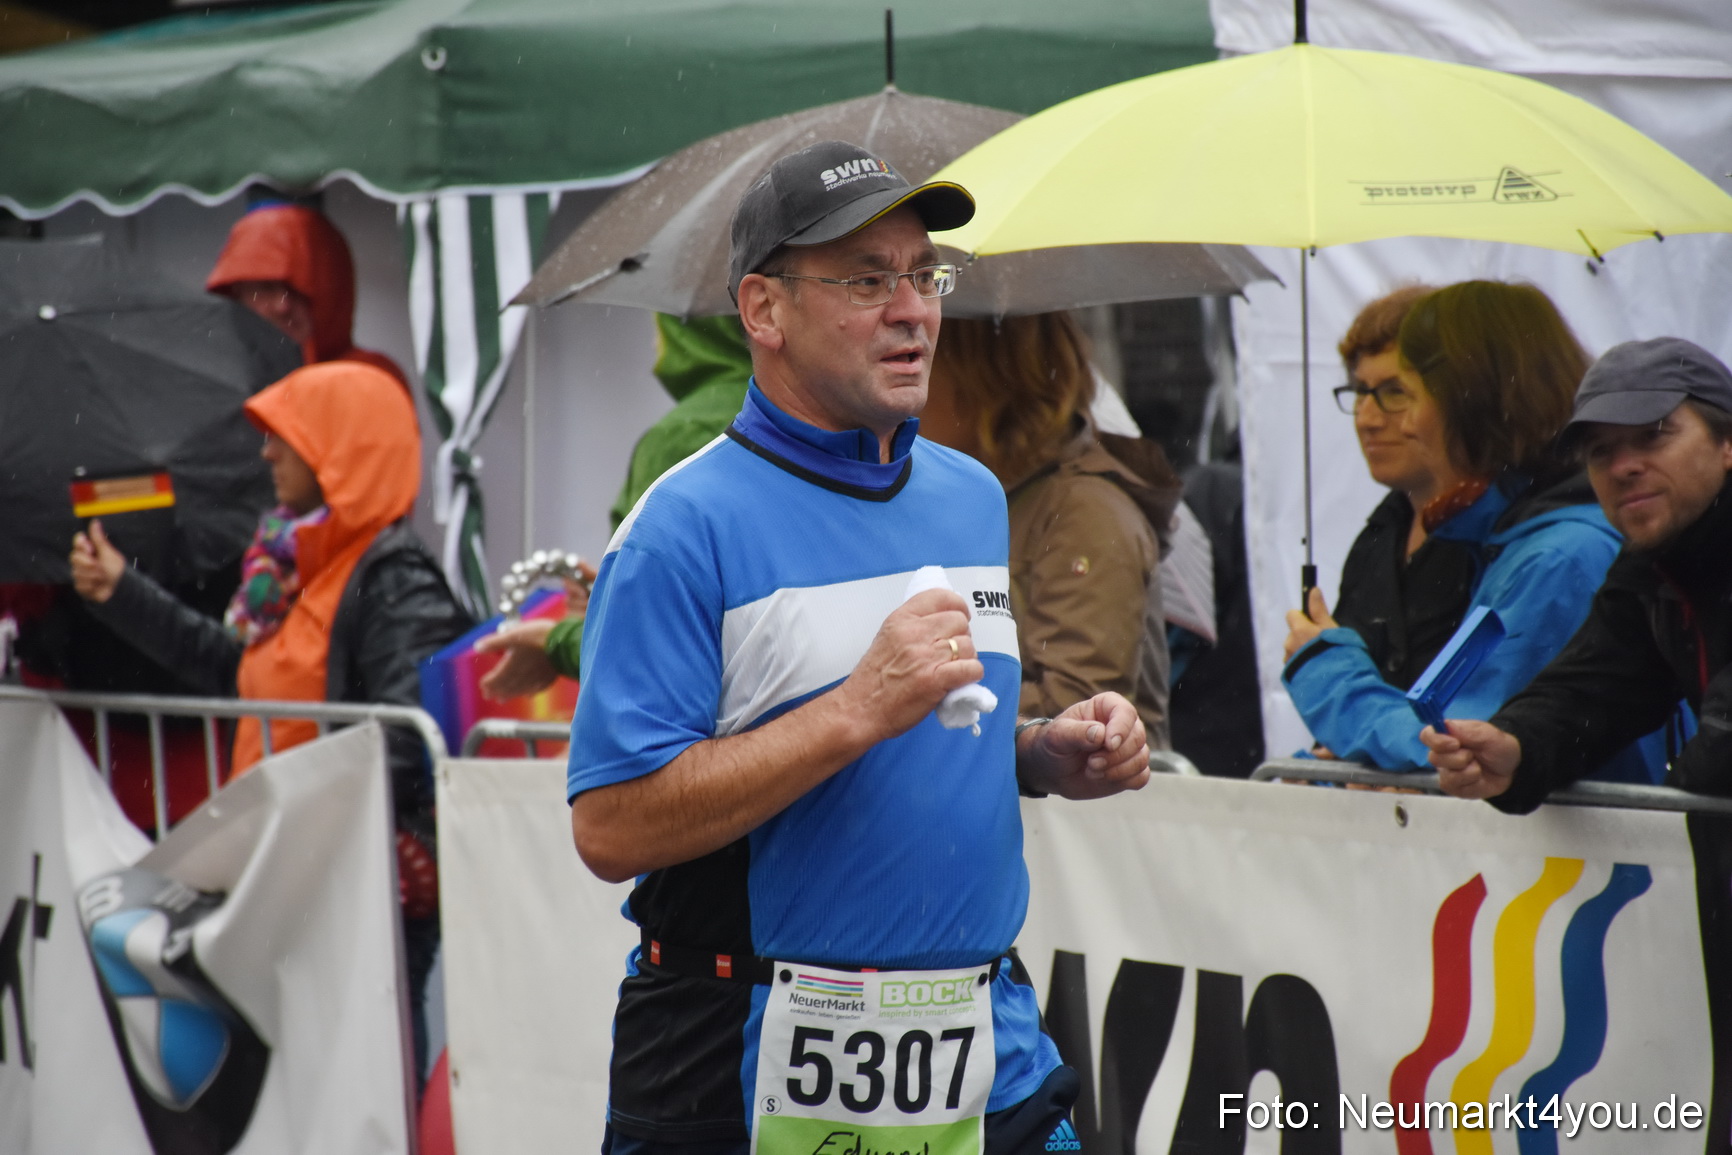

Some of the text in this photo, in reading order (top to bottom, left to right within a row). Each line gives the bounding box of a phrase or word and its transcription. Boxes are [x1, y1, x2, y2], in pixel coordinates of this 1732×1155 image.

[820, 158, 880, 185] swn
[972, 590, 1010, 609] swn
[788, 992, 866, 1012] NeuerMarkt
[880, 976, 975, 1008] BOCK
[879, 1009, 912, 1019] inspired
[913, 1009, 924, 1018] by
[925, 1008, 948, 1016] smart
[1042, 949, 1343, 1155] wn
[786, 1025, 976, 1115] 5307
[1045, 1139, 1081, 1151] adidas
